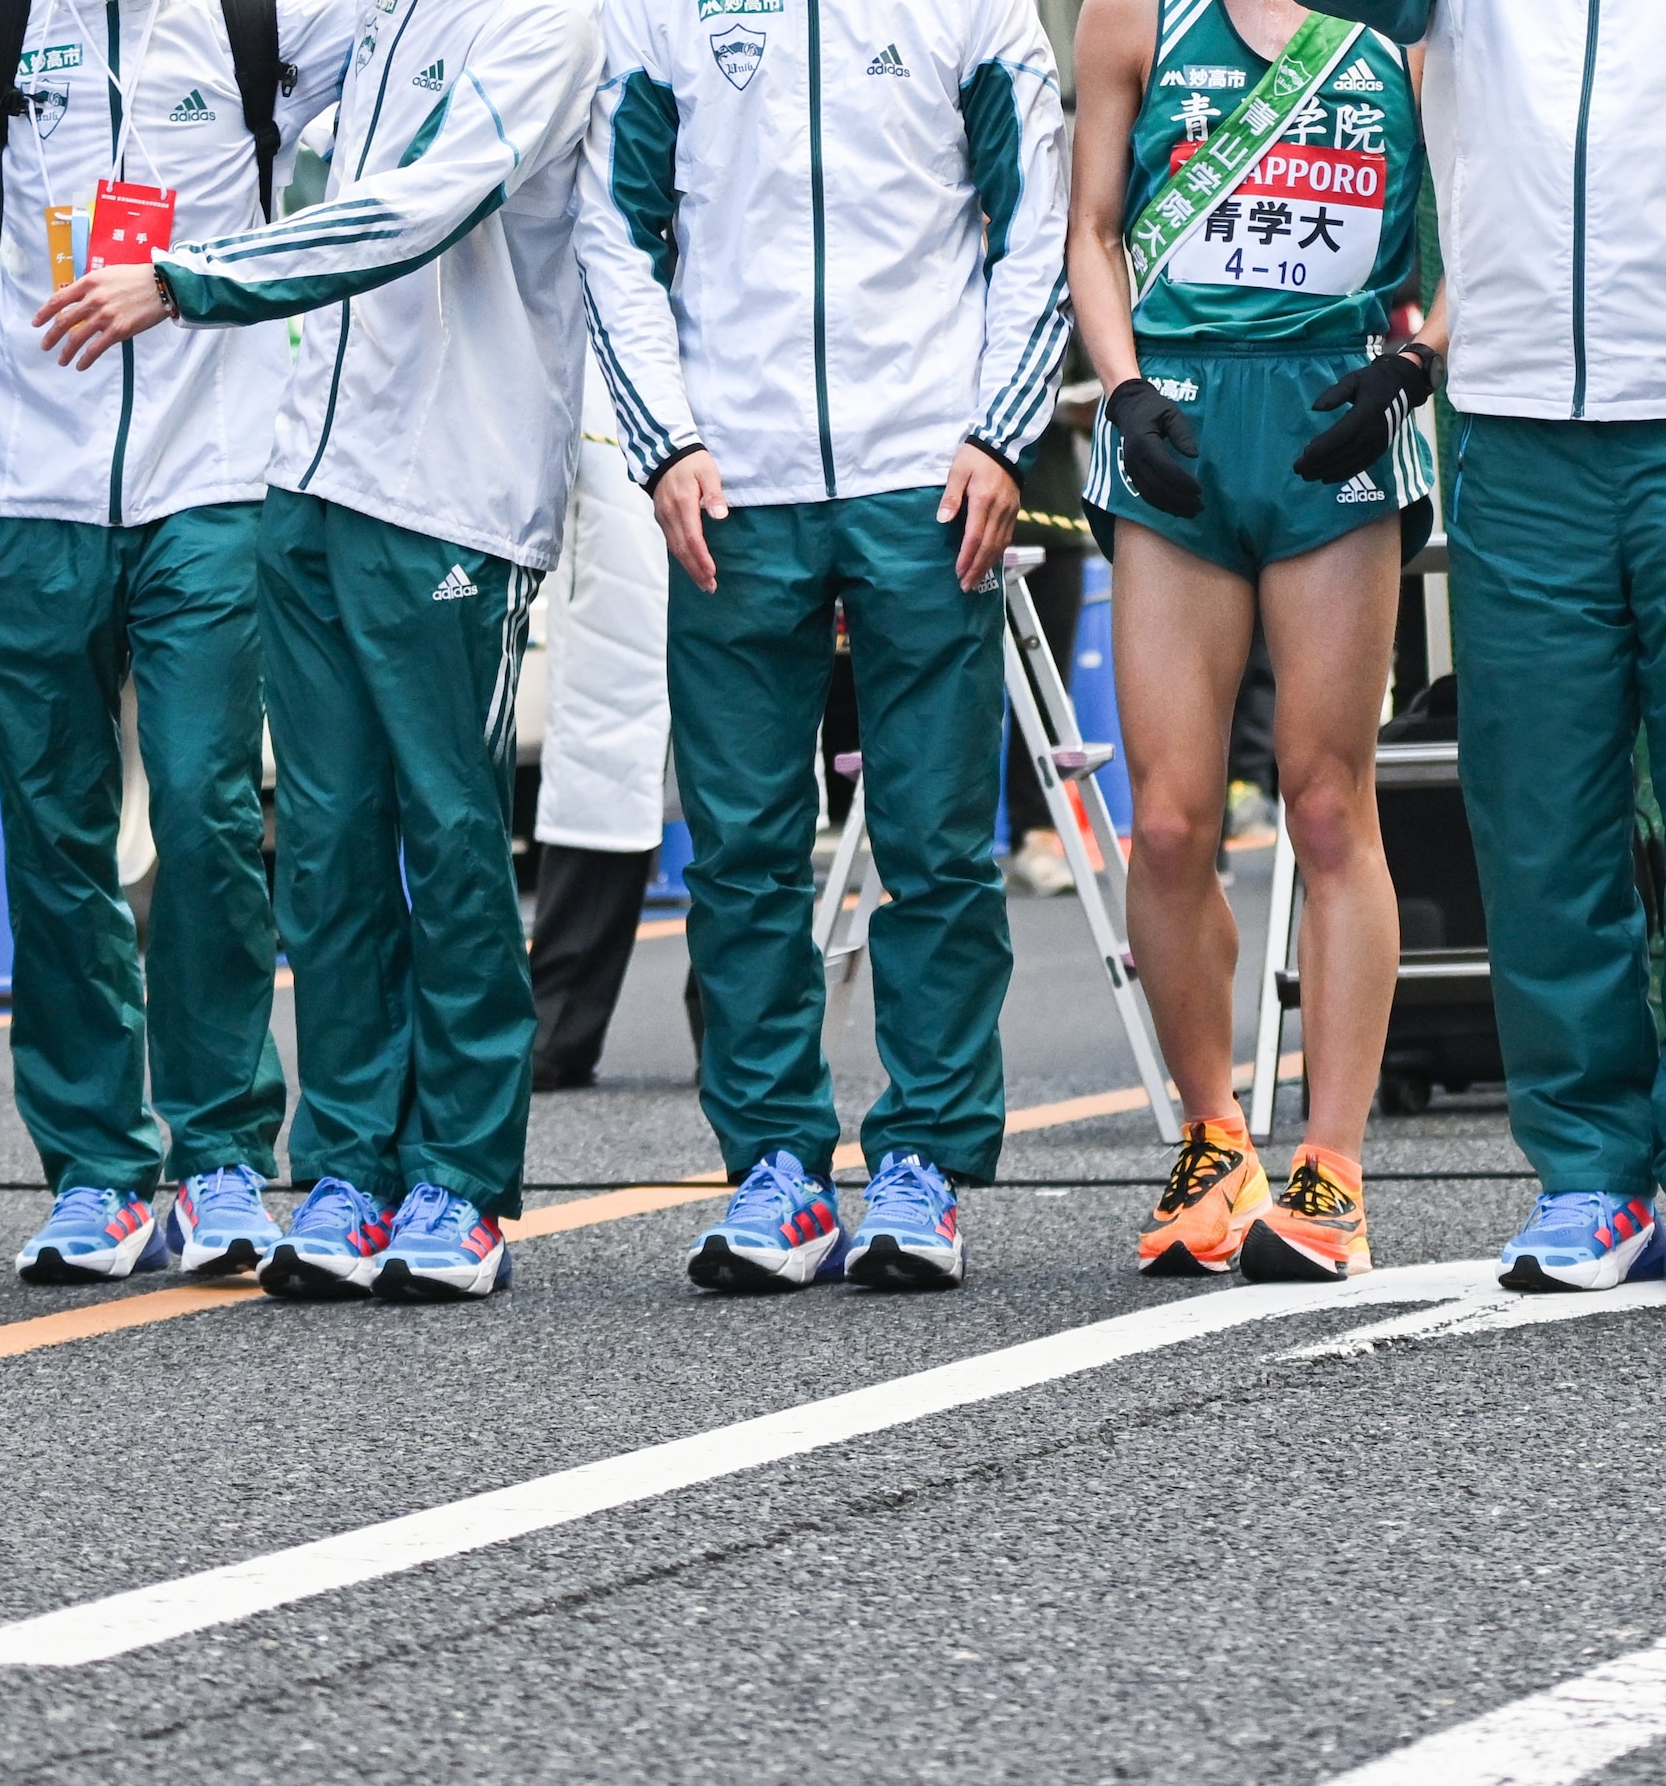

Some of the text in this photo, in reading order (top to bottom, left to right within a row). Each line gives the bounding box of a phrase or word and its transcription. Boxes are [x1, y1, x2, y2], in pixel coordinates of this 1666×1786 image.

[866, 63, 911, 78] adidas
[412, 76, 444, 92] adida
[1189, 69, 1246, 89] 妙高市
[1333, 79, 1384, 92] adidas
[169, 109, 216, 122] adidas
[1170, 92, 1386, 154] 青学院
[1244, 155, 1378, 197] APPORO
[1203, 200, 1344, 253] 青学大
[1336, 490, 1385, 504] adidas
[432, 585, 478, 601] adidas
